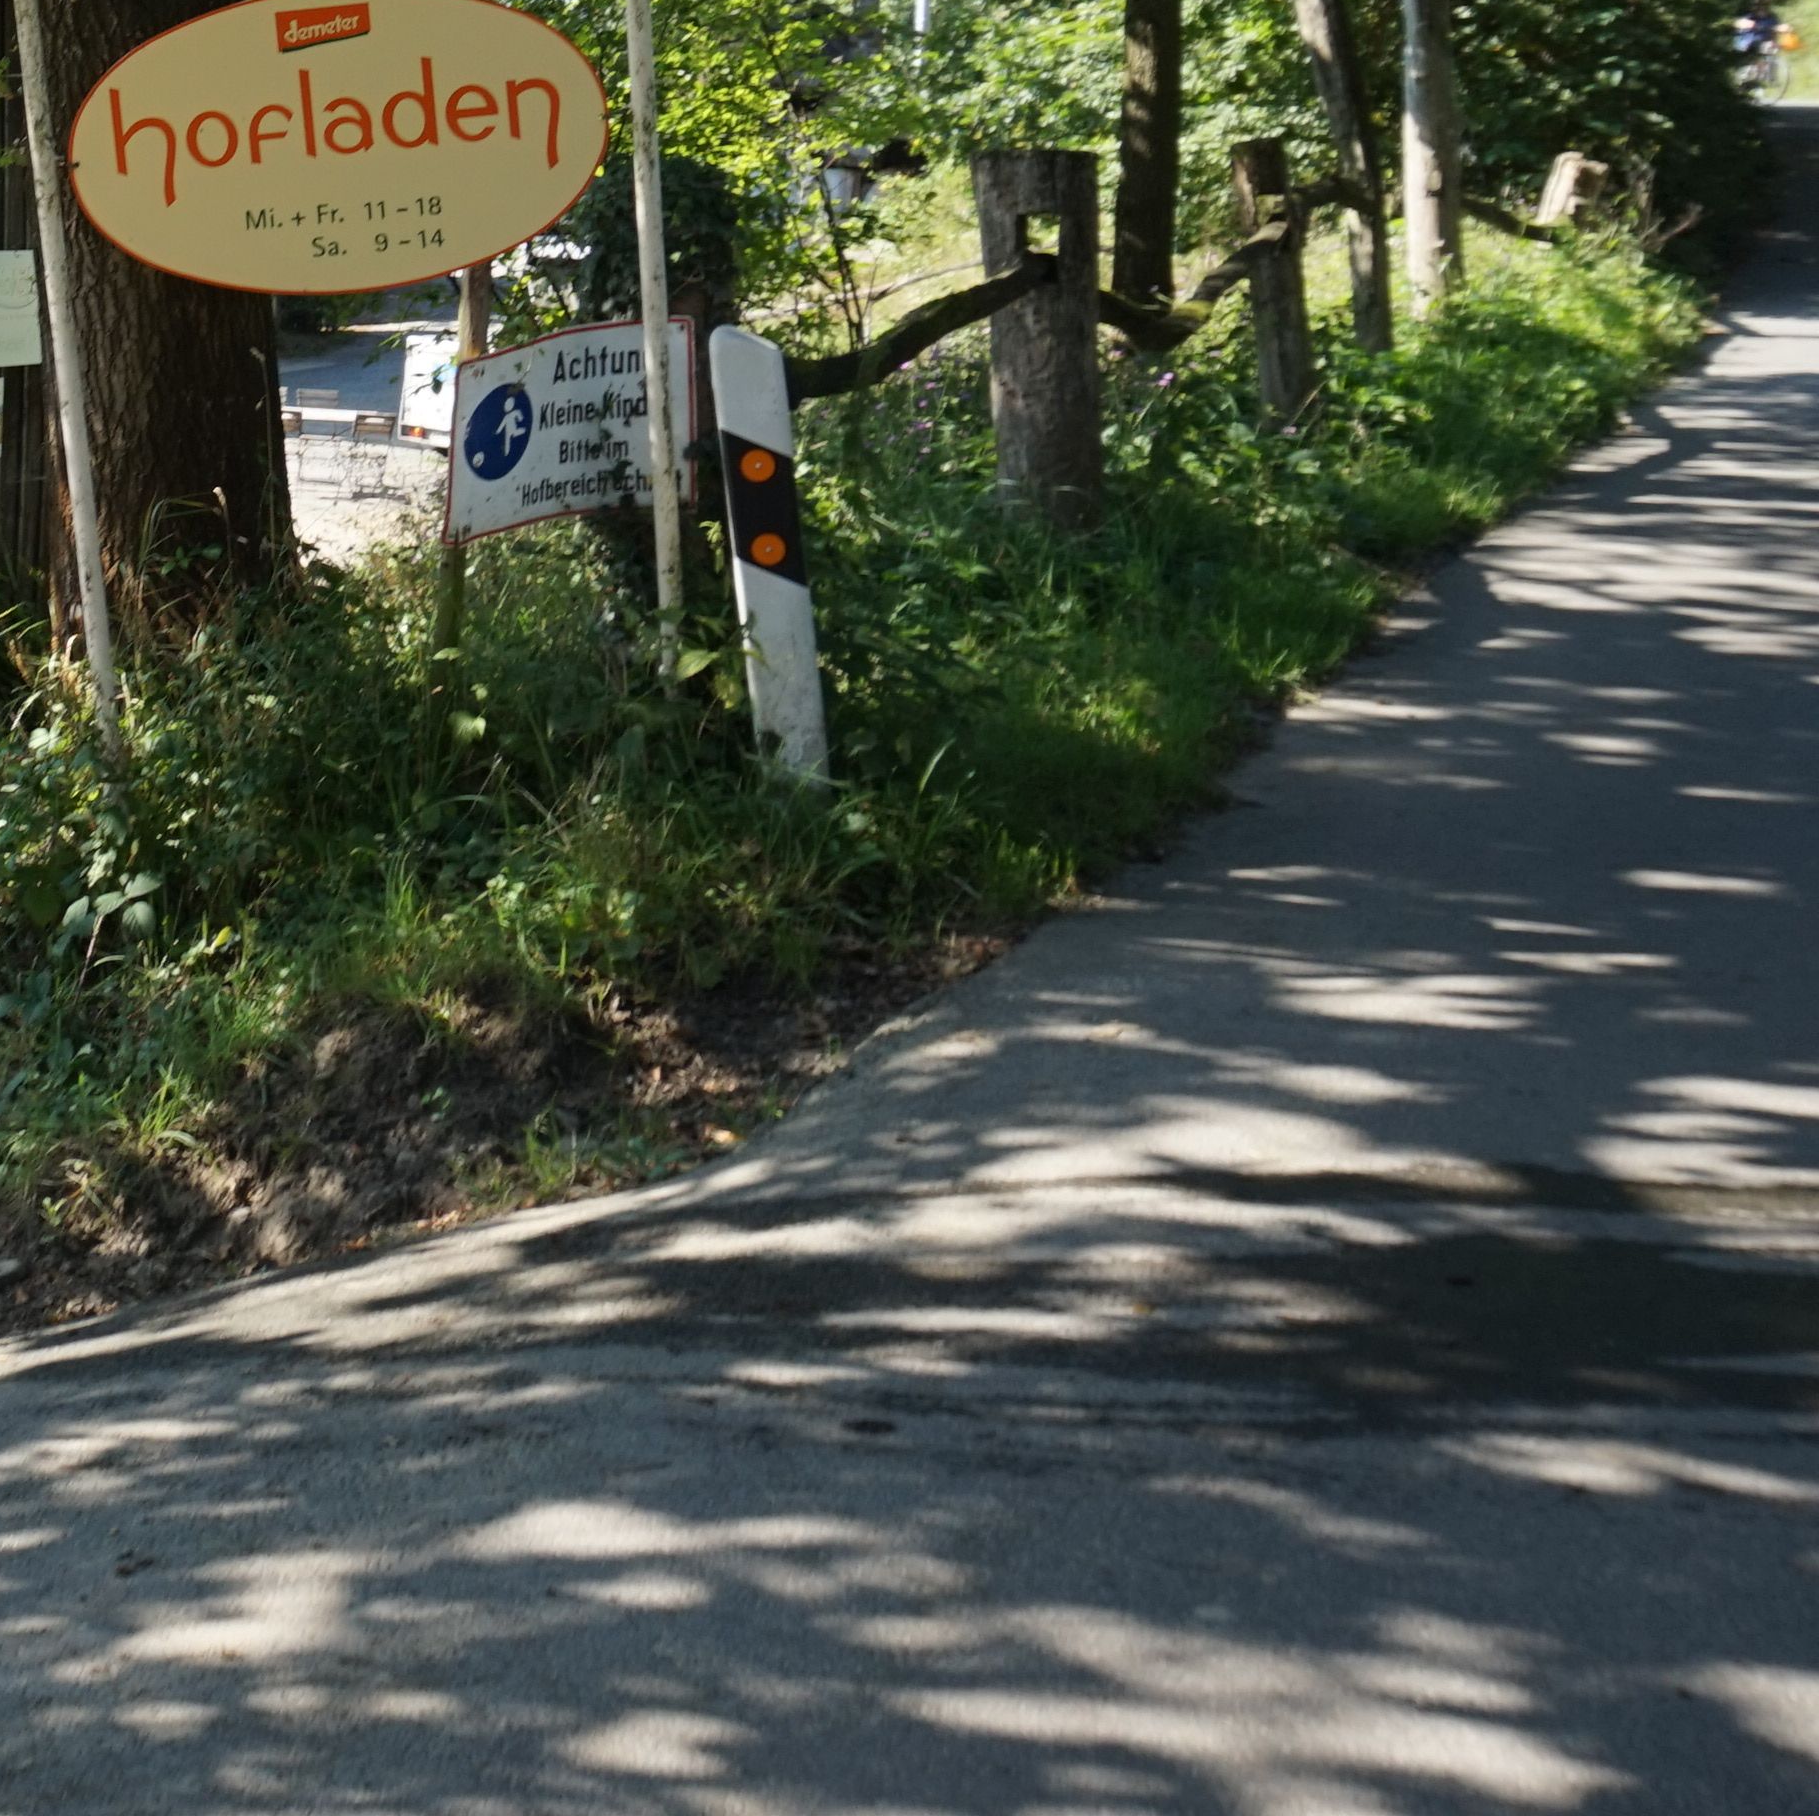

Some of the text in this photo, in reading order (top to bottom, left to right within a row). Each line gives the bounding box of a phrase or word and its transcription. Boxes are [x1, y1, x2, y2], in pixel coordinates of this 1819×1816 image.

[283, 14, 360, 43] demeter
[109, 56, 560, 207] hofladen
[245, 208, 283, 230] Mi.
[291, 211, 306, 226] +
[316, 203, 345, 224] Fr.
[364, 201, 386, 221] 11
[415, 196, 442, 217] 18
[311, 236, 347, 258] Sa.
[374, 232, 389, 253] 9
[417, 229, 445, 249] 14
[552, 345, 646, 386] Achtun
[538, 388, 649, 431] Kleine Kind
[607, 439, 630, 459] im
